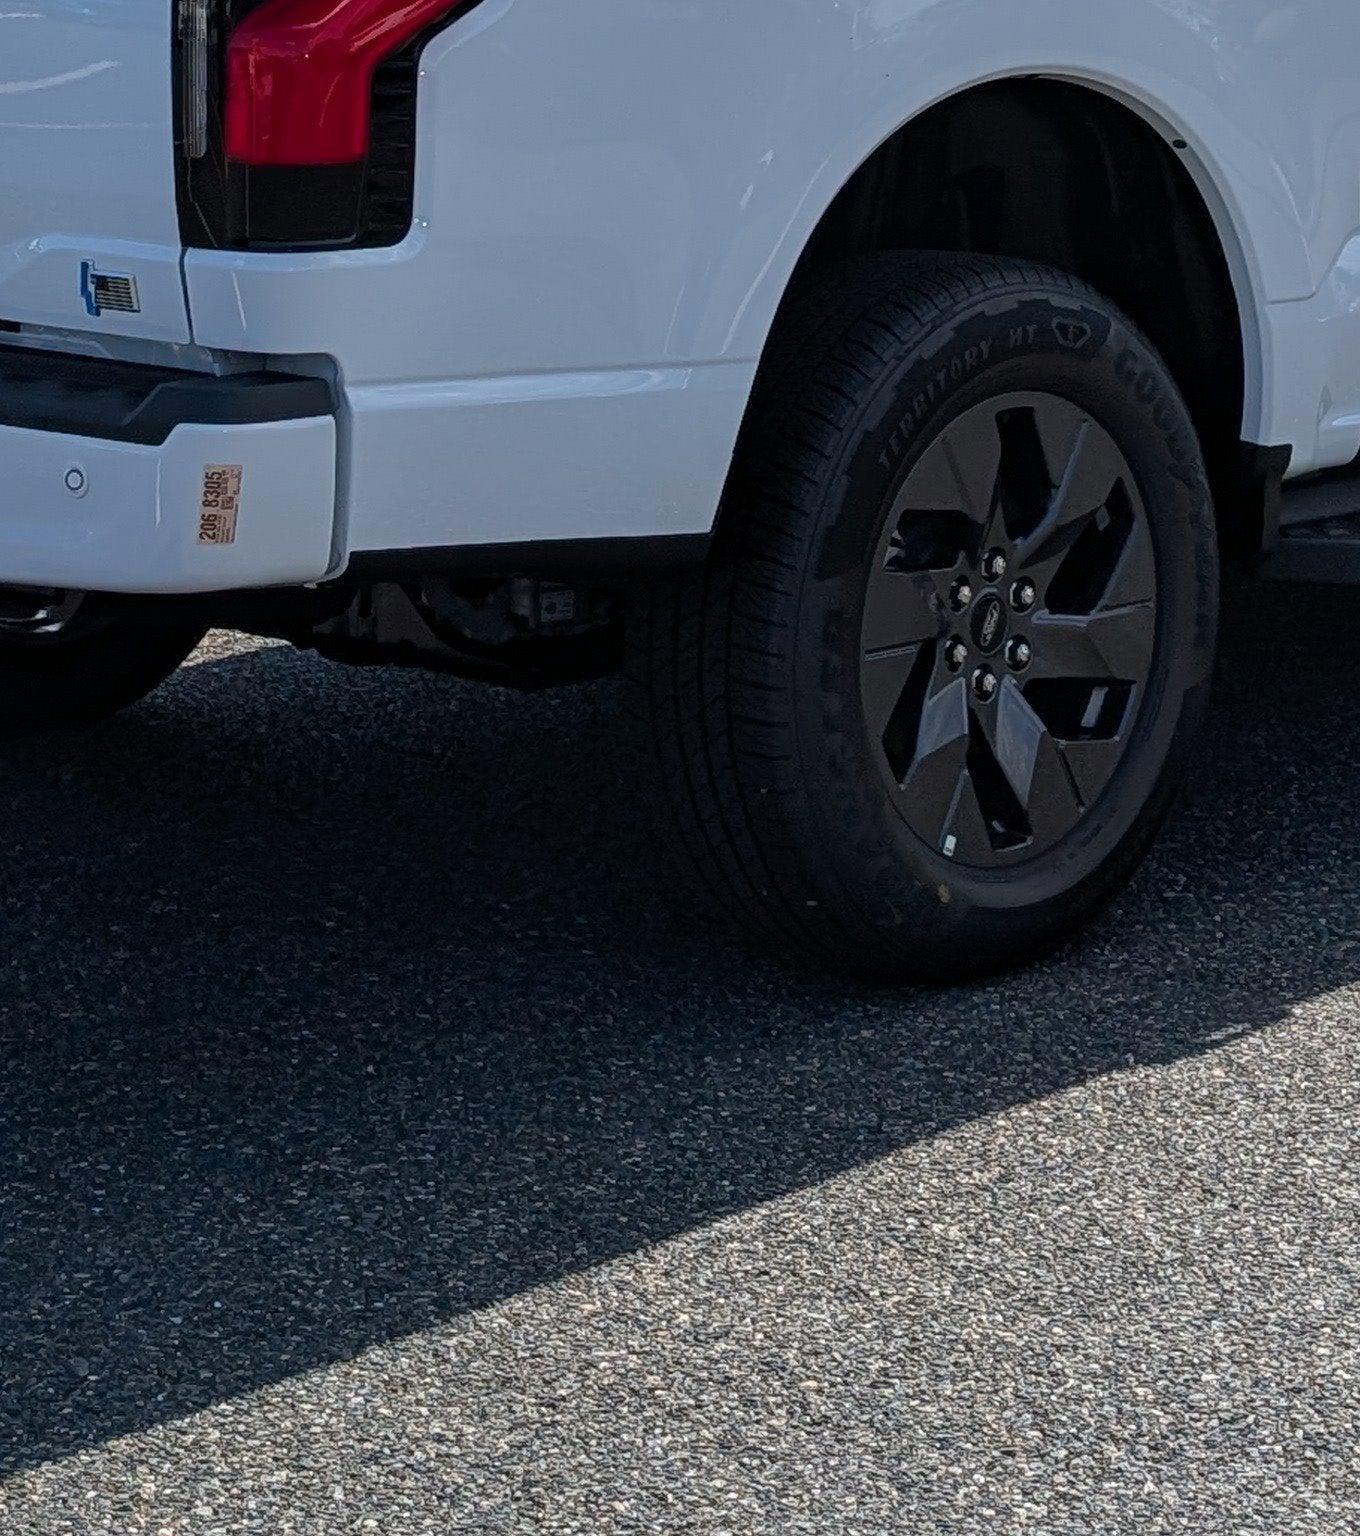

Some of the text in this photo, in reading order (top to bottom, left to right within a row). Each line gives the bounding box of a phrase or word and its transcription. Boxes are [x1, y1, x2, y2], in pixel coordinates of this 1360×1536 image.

[877, 338, 993, 469] TERRITORY
[199, 471, 222, 540] 206 8305
